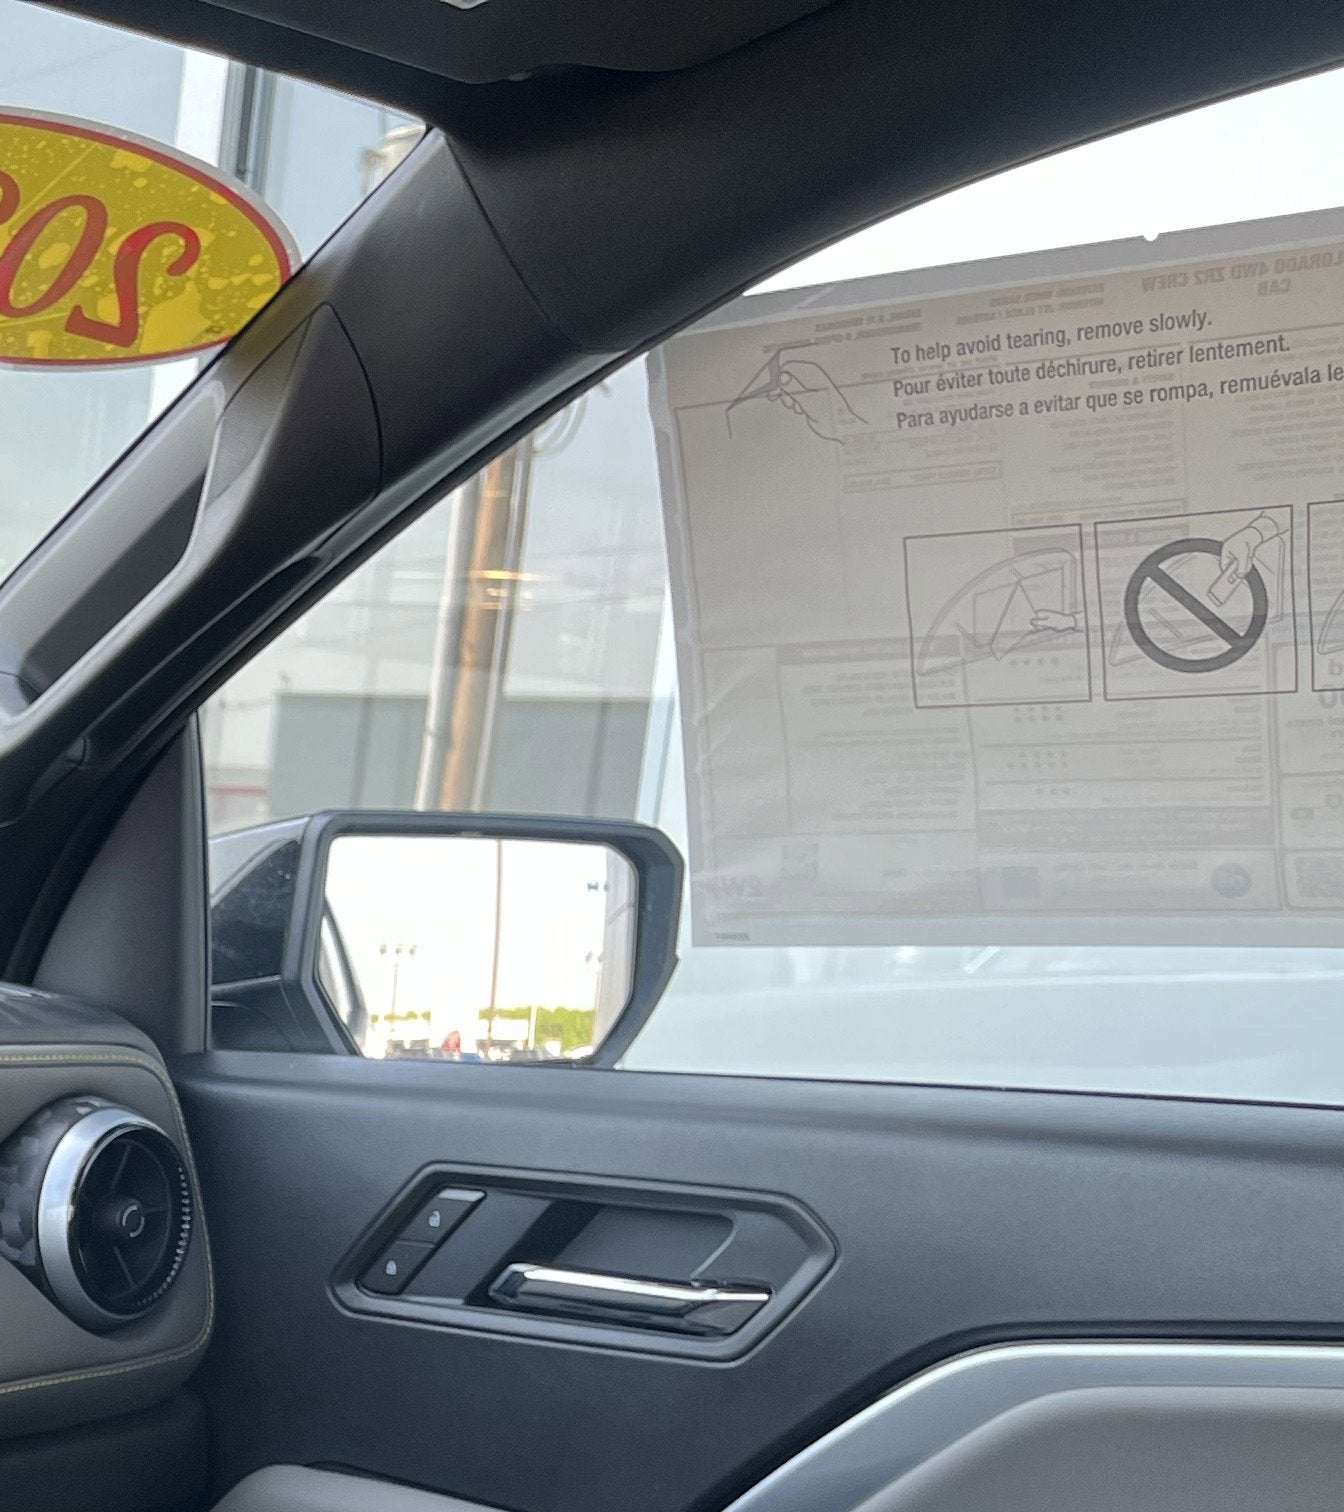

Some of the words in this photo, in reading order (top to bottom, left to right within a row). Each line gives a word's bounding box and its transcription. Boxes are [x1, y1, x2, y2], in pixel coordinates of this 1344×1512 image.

[891, 347, 911, 365] To
[915, 341, 951, 363] help
[956, 334, 1002, 356] avoid
[1006, 327, 1072, 350] tearing,
[1077, 319, 1144, 342] remove
[1149, 309, 1213, 333] slowly.
[893, 379, 931, 398] Pour
[936, 369, 984, 392] éviter
[988, 366, 1031, 386] toute
[1035, 357, 1122, 381] déchirure,
[1128, 349, 1184, 371] retirer
[1189, 334, 1291, 364] lentement.
[896, 411, 935, 429] Para
[939, 401, 1013, 427] ayudarse
[1018, 402, 1030, 416] a
[1034, 394, 1081, 415] evitar
[1085, 391, 1117, 413] que
[1123, 388, 1144, 405] se
[1149, 381, 1214, 403] rompa,
[1220, 366, 1321, 395] remuévala
